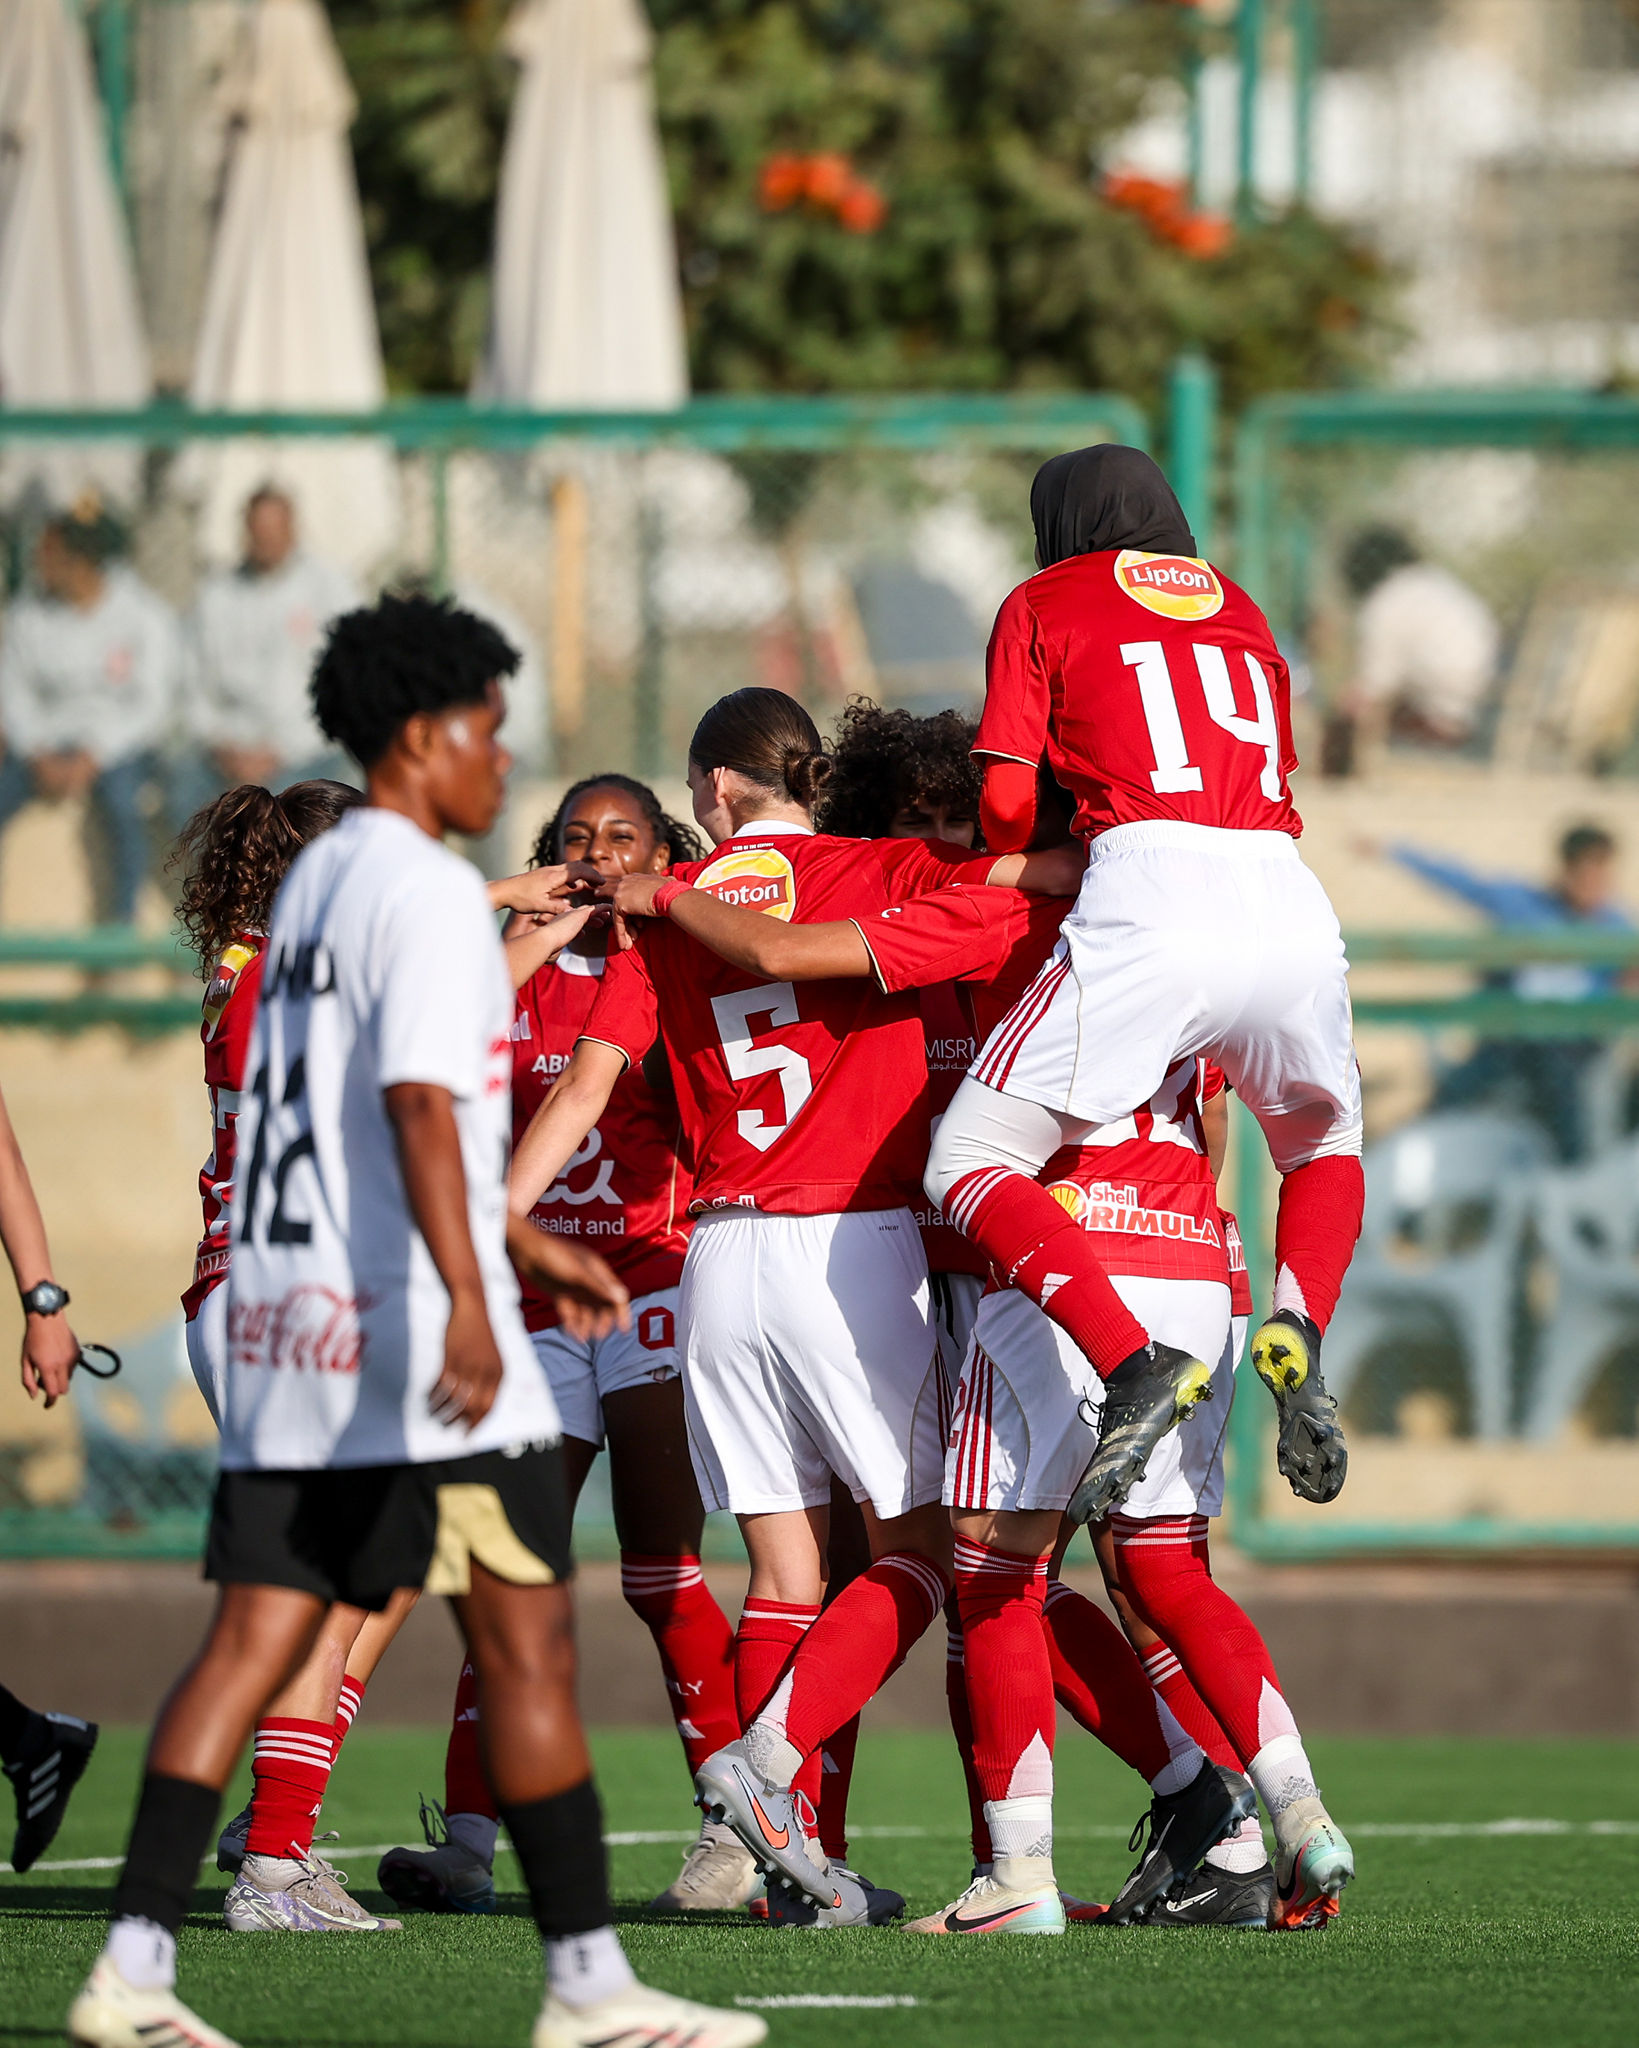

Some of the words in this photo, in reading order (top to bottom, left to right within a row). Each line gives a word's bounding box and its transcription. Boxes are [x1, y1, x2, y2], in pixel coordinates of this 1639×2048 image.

[1131, 567, 1210, 590] Lipton
[1119, 640, 1286, 803] 14
[706, 883, 780, 906] ipton
[710, 981, 814, 1152] 5
[1090, 1183, 1138, 1207] Shell
[528, 1213, 582, 1236] tisalat
[586, 1217, 625, 1236] and
[1087, 1205, 1221, 1248] RIMULA
